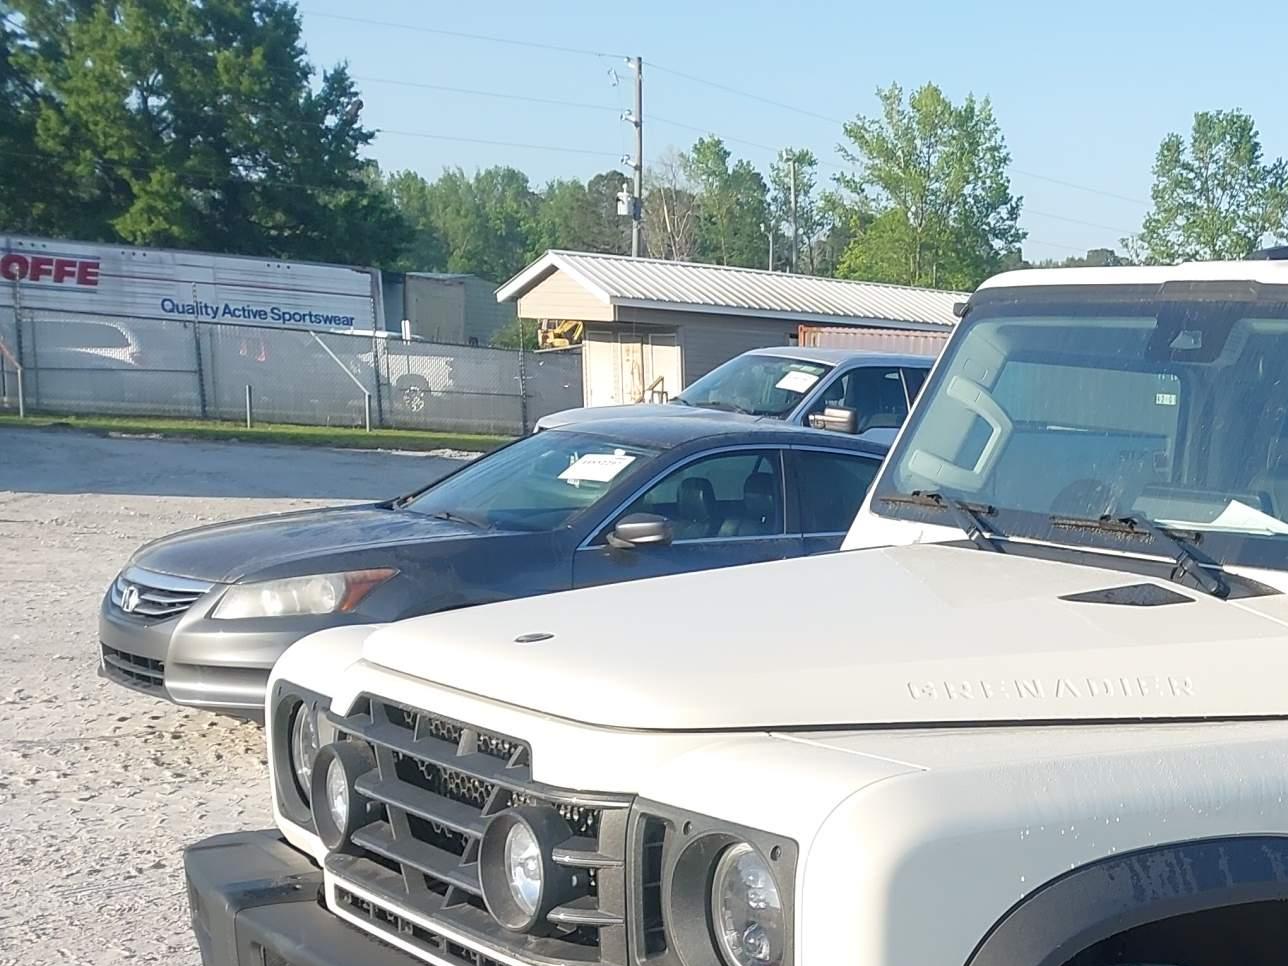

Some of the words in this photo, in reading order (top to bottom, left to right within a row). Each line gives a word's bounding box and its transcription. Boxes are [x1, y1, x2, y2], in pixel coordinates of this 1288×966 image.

[1, 253, 100, 286] OFFE
[160, 298, 219, 319] Quality
[222, 303, 268, 321] Active
[270, 306, 355, 327] Sportswear
[906, 676, 1198, 700] GRENADIER
